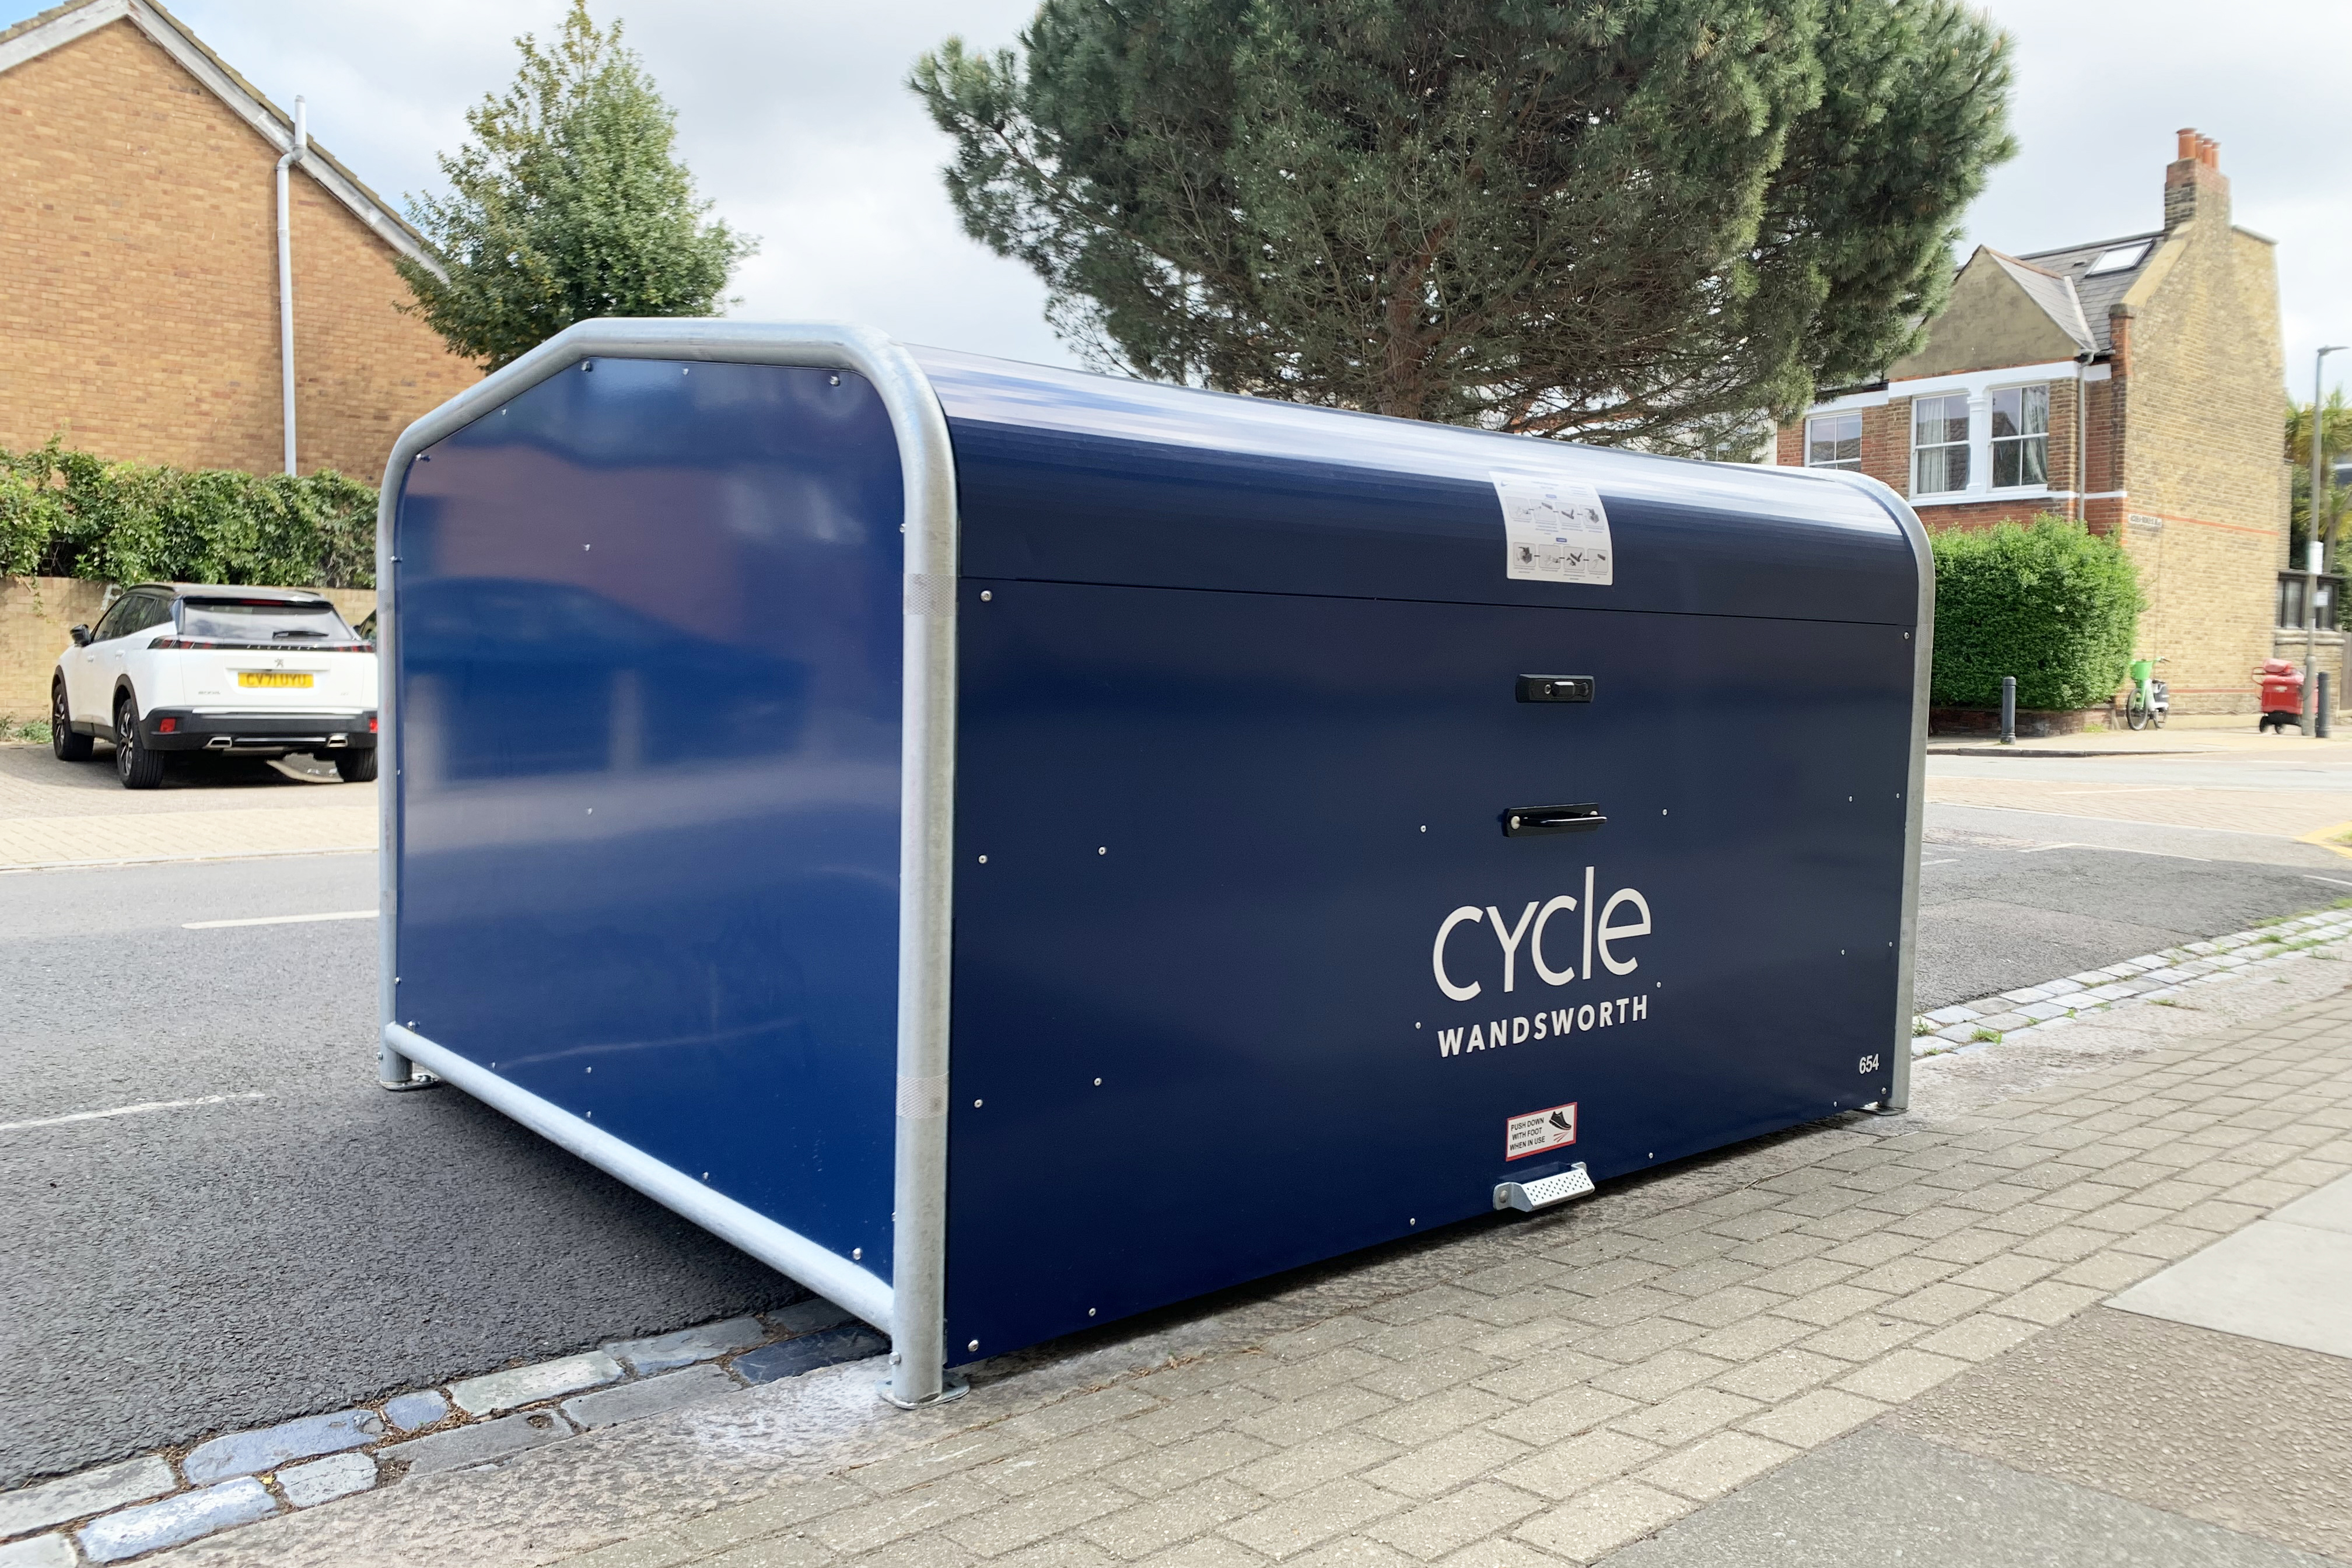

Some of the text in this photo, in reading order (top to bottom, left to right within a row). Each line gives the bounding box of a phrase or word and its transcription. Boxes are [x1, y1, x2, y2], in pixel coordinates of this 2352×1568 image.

[1433, 866, 1651, 1002] cycle
[1437, 995, 1648, 1058] WANDSWORTH
[1859, 1053, 1880, 1074] 654
[1511, 1117, 1544, 1131] PUSH DOWN
[1512, 1127, 1542, 1140] WITH FOOT
[1510, 1140, 1527, 1151] WHEN
[1534, 1136, 1545, 1144] USE
